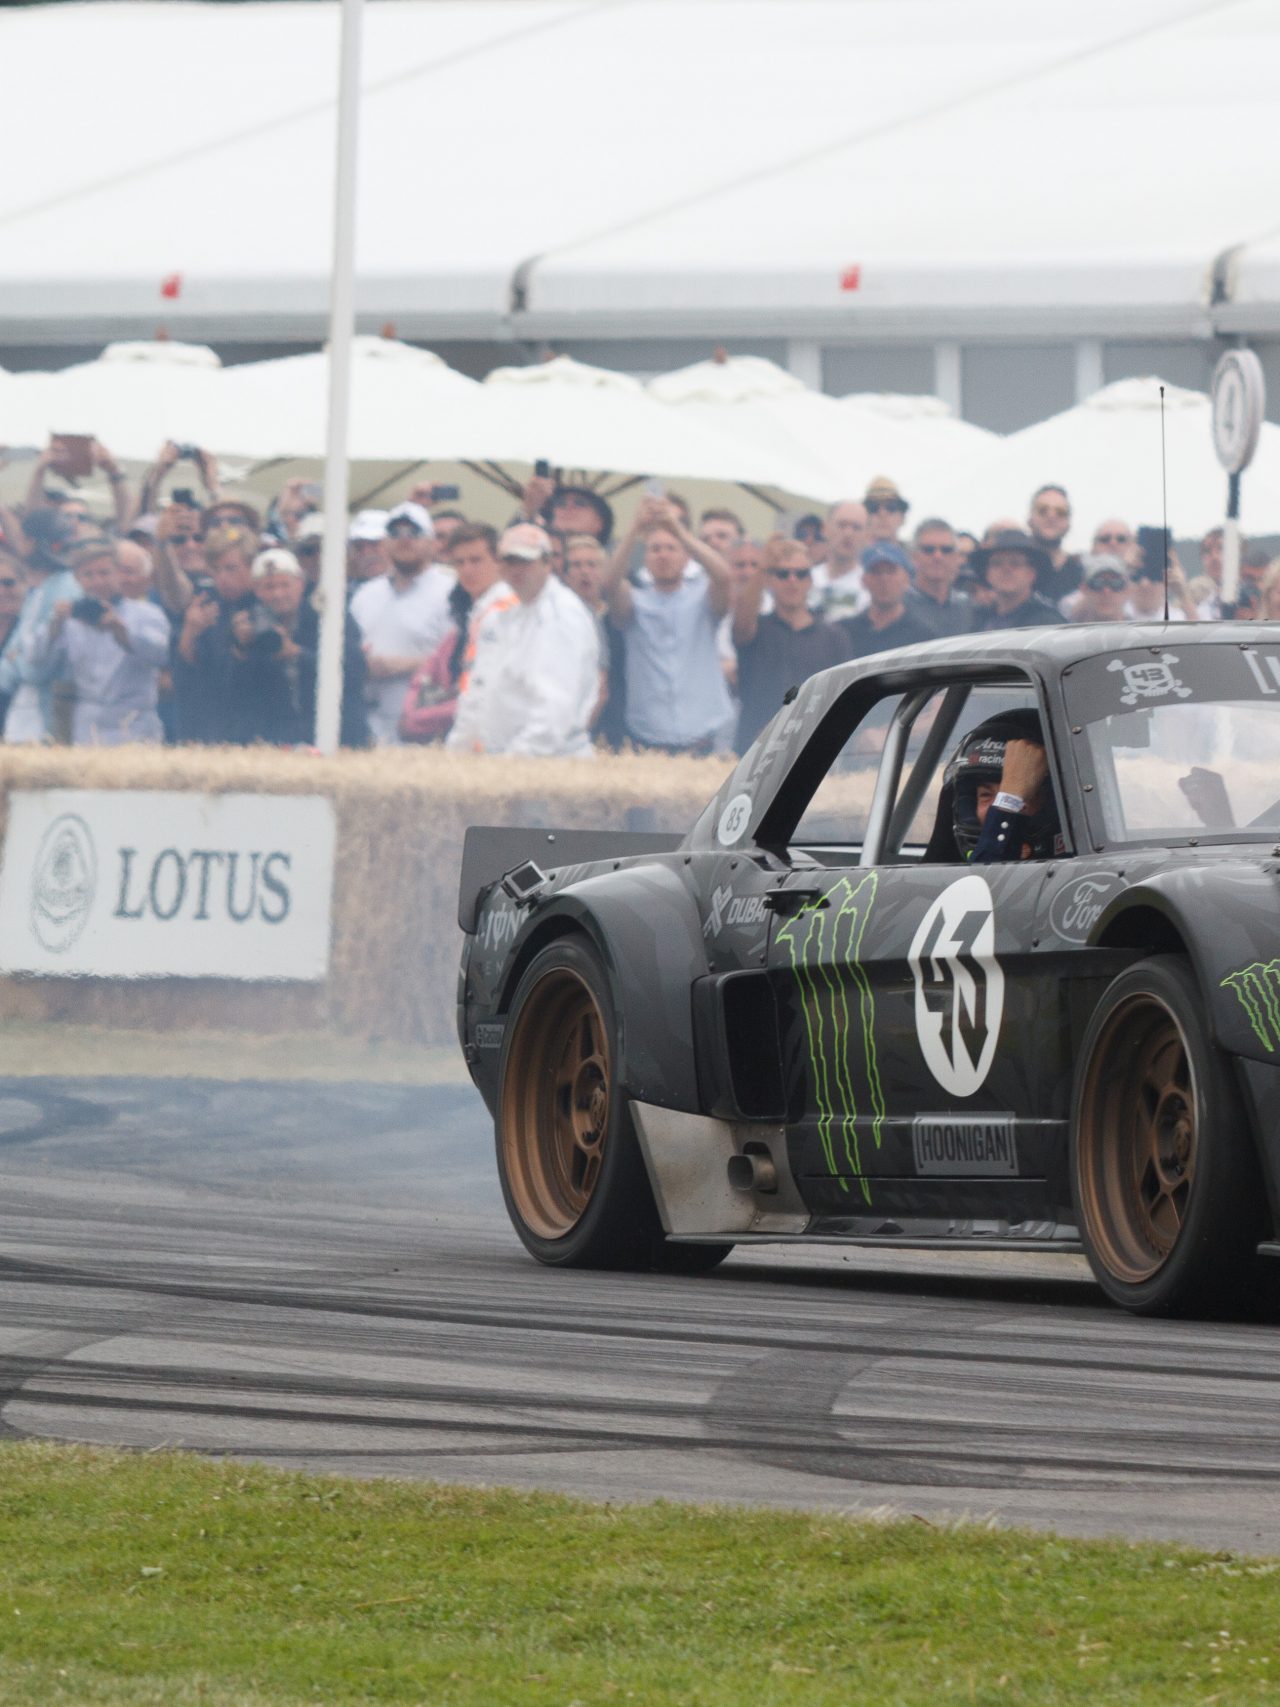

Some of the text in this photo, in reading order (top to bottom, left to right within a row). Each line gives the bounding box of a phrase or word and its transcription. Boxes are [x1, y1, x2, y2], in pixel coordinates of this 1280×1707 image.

[726, 807, 744, 831] 85
[113, 847, 292, 924] LOTUS
[1062, 881, 1111, 929] For
